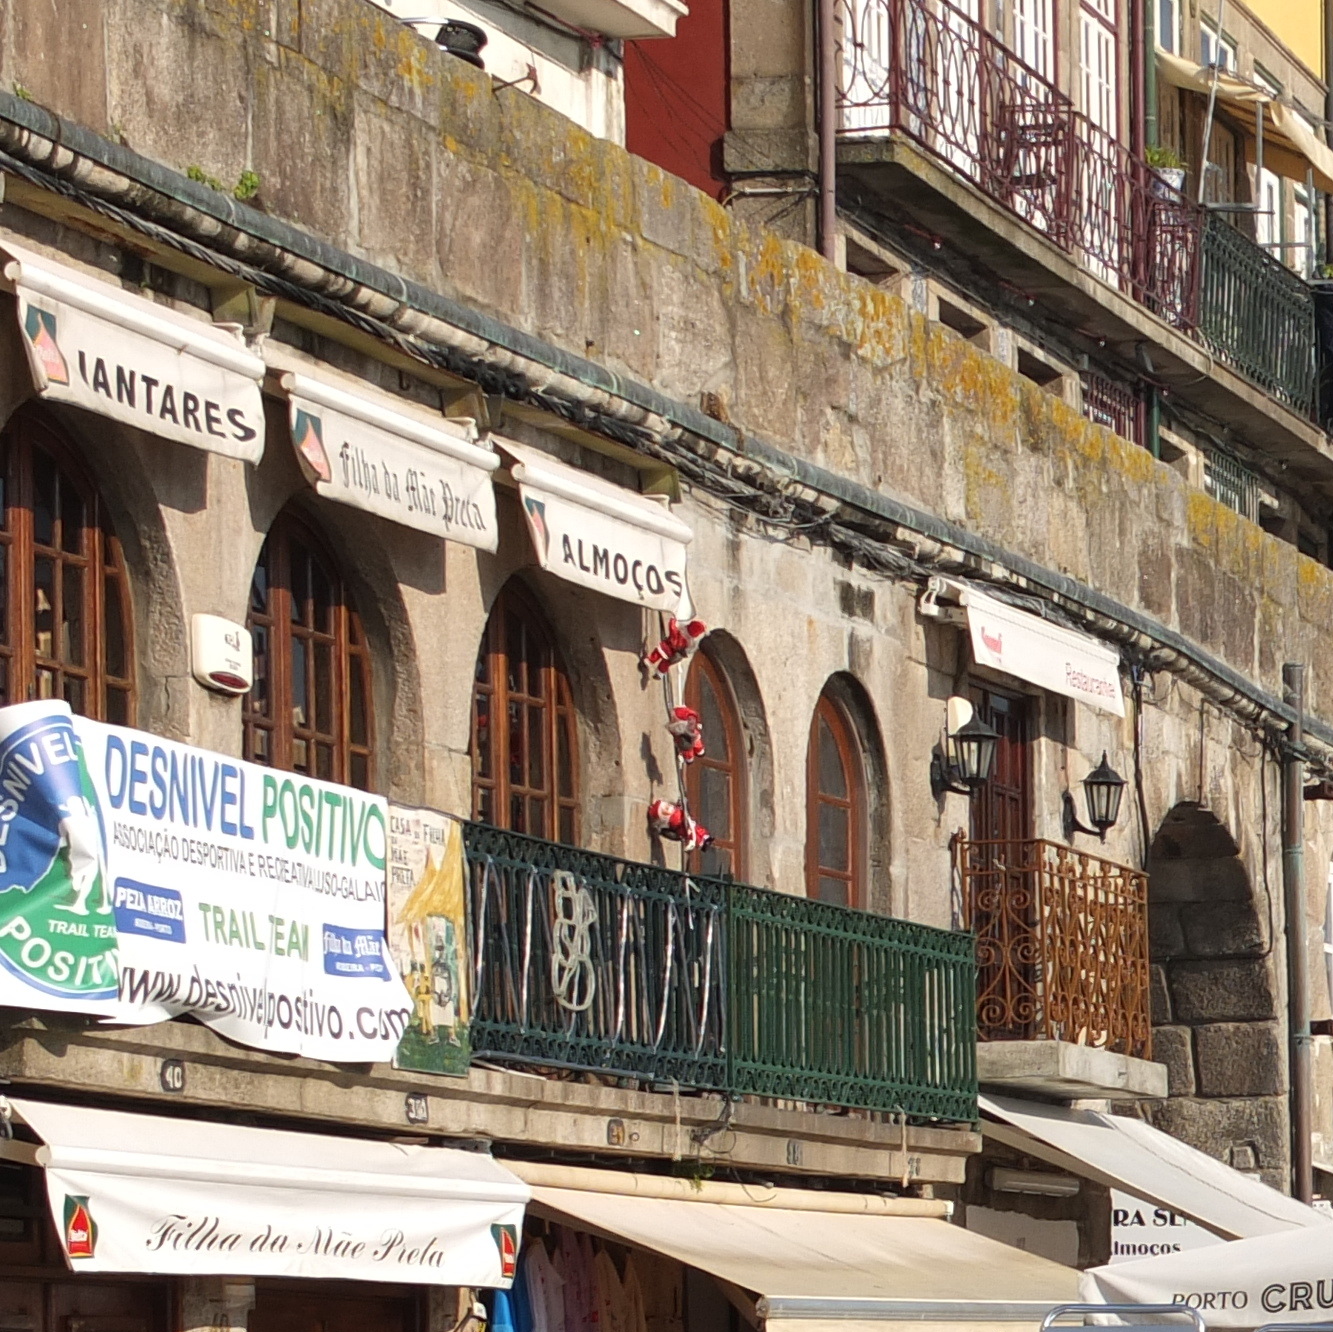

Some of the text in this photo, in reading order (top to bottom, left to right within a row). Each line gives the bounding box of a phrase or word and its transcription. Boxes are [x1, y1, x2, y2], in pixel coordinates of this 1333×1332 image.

[562, 533, 683, 600] ALMOÇOS
[105, 734, 387, 871] DESNIVEL POSITIVO
[48, 919, 89, 938] TRAIL
[198, 902, 266, 950] TRAIL
[165, 1065, 182, 1090] 40
[145, 1213, 242, 1253] Filha
[249, 1226, 290, 1254] da
[297, 1226, 366, 1259] Mãe
[1172, 1290, 1248, 1311] PORTO
